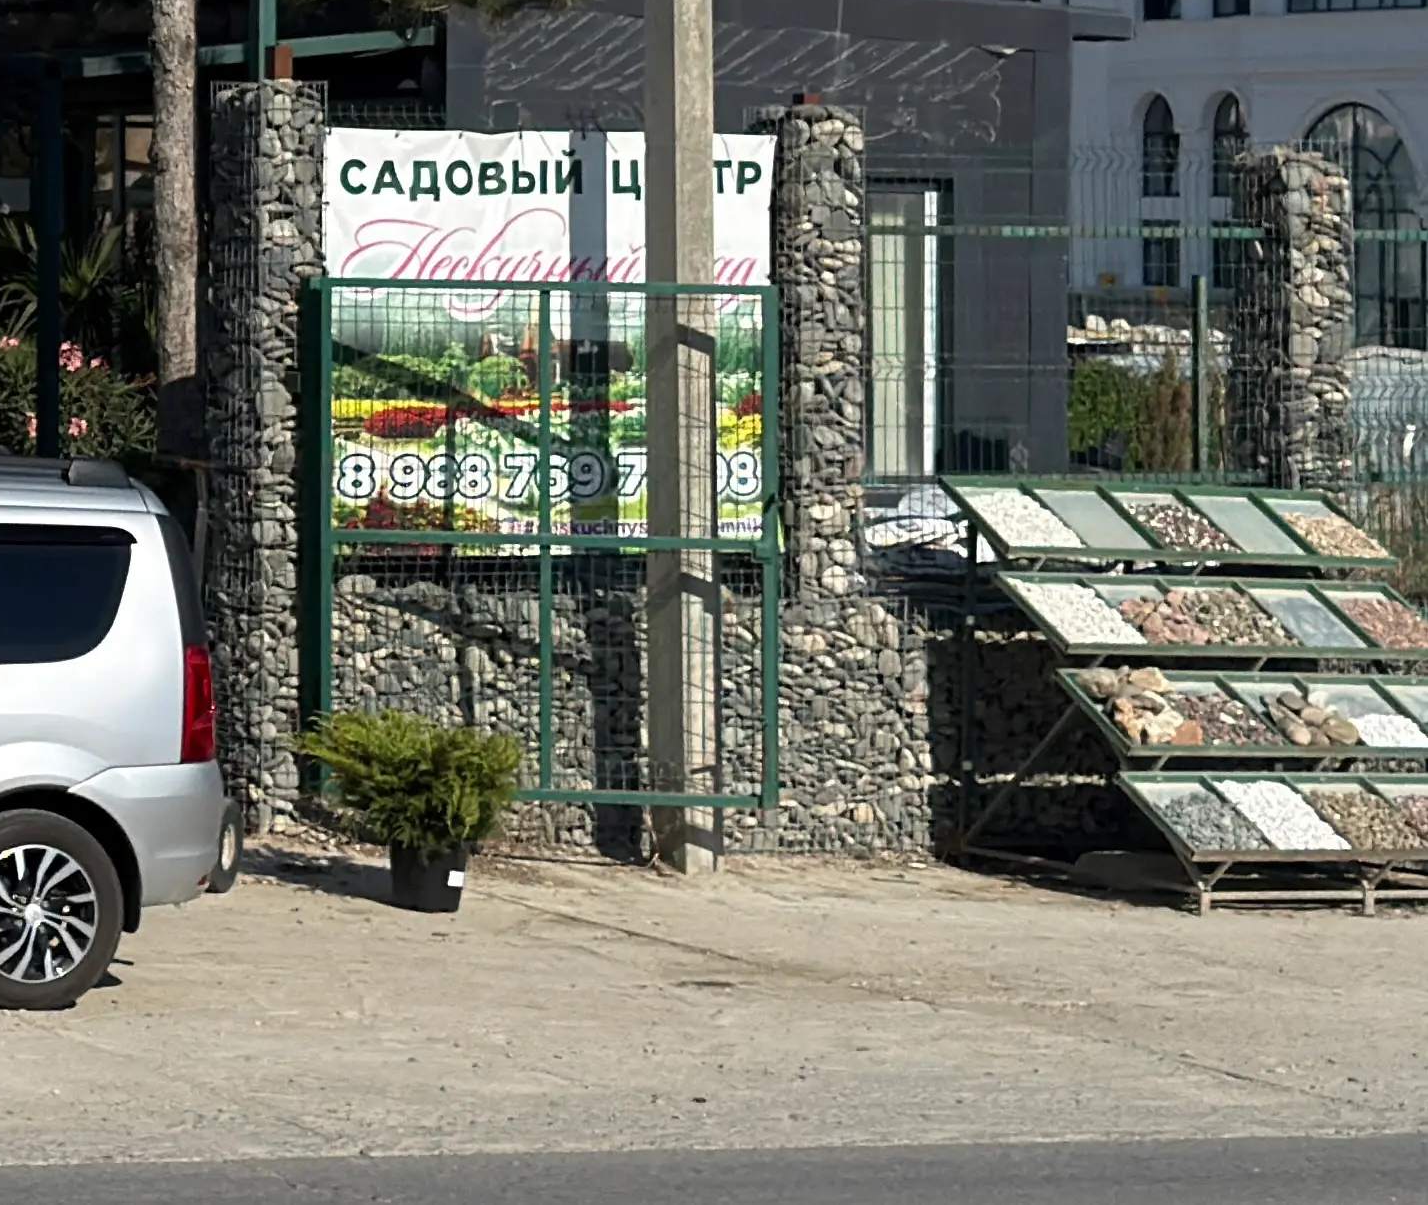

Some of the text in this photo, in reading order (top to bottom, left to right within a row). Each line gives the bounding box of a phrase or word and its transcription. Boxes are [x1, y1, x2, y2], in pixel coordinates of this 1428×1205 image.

[339, 149, 762, 202] САДОВЫЙ ЦТР
[337, 452, 376, 498] 8
[389, 452, 493, 499] 988
[504, 452, 605, 497] 769
